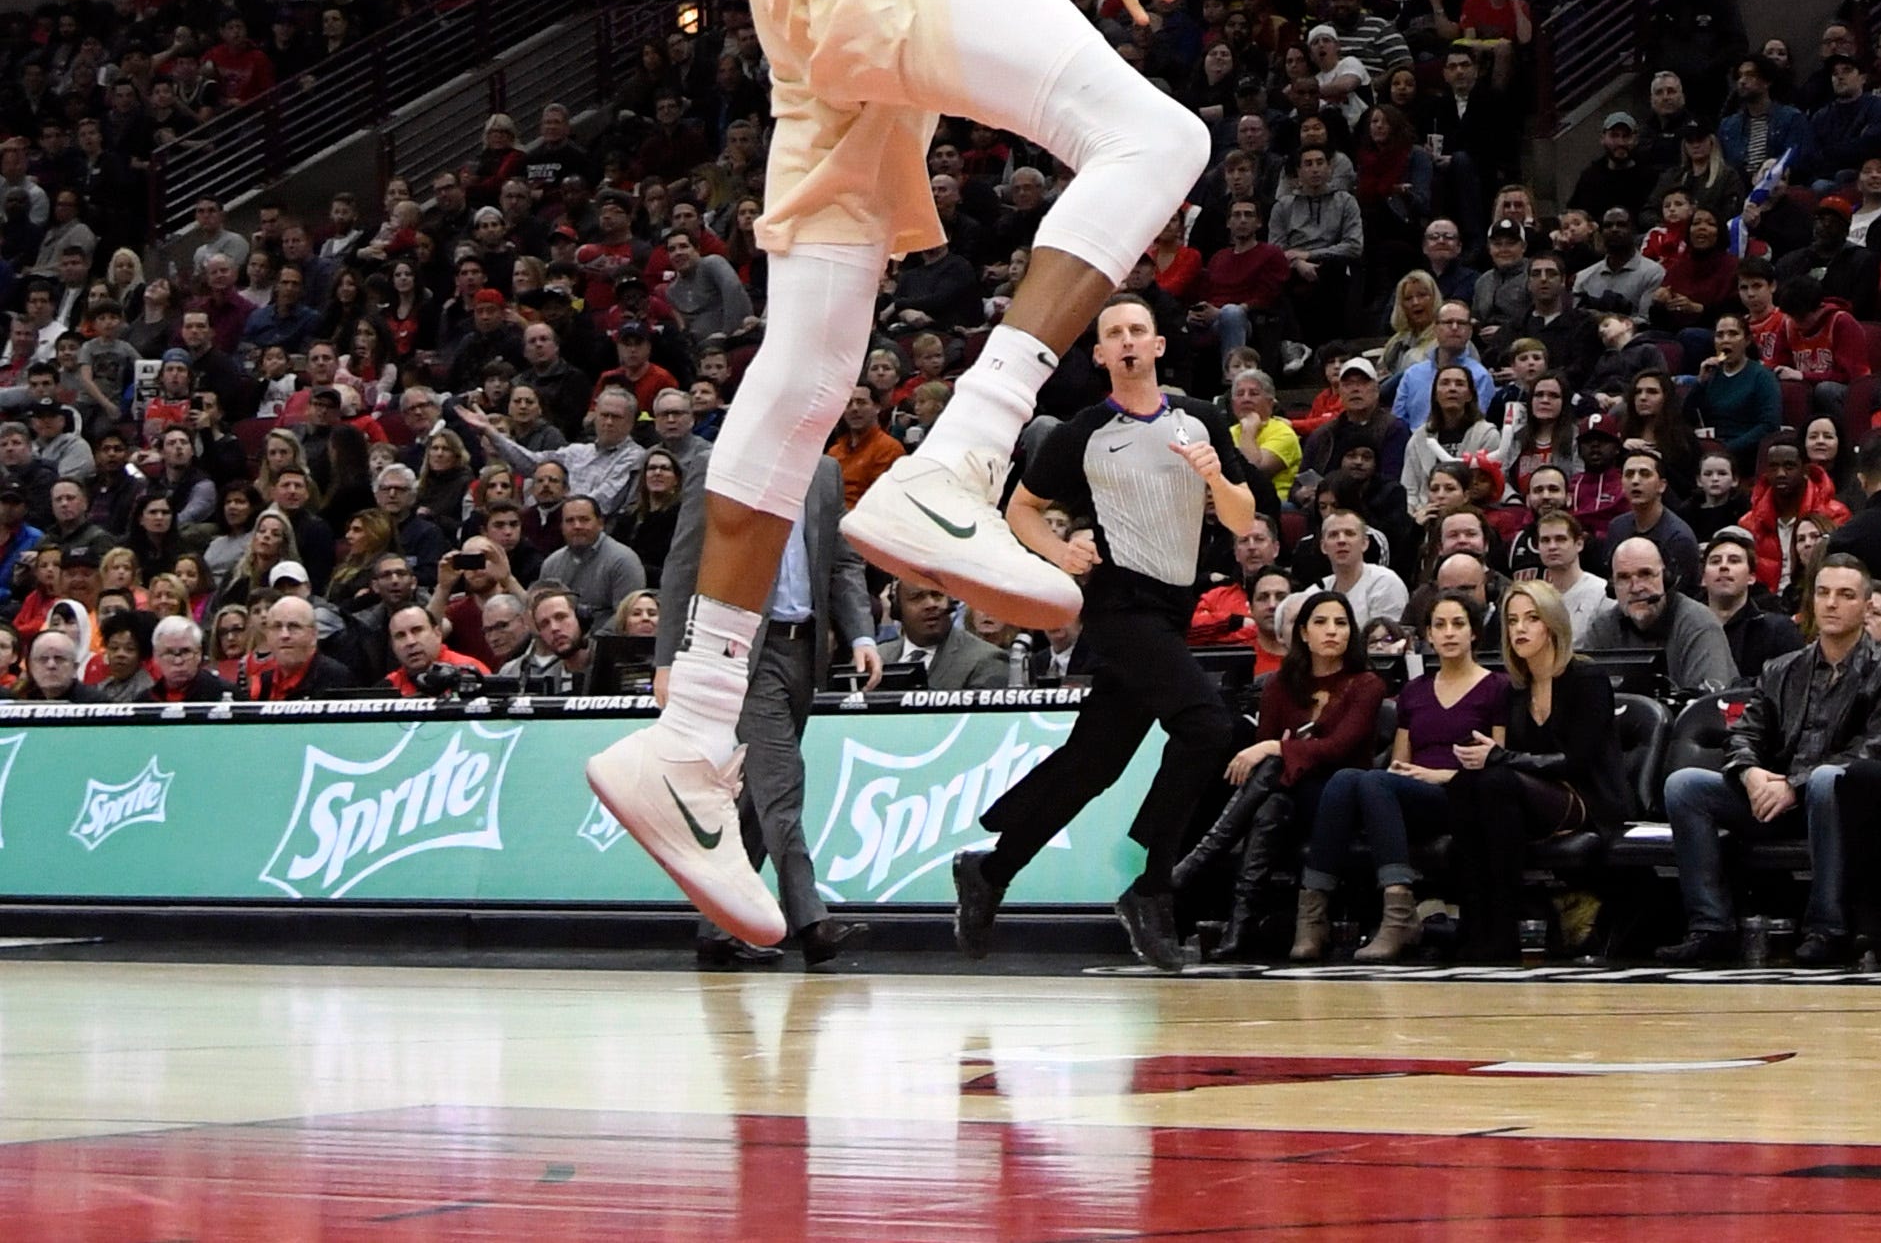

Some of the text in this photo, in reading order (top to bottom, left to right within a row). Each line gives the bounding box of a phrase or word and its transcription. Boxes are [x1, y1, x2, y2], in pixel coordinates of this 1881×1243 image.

[260, 699, 437, 715] ADIDAS BASKETBALL
[563, 695, 634, 711] ADIDAS
[900, 691, 974, 707] ADIDAS
[34, 705, 135, 718] BASKETBALL
[82, 773, 162, 838] Sprite
[287, 730, 490, 889] Sprite
